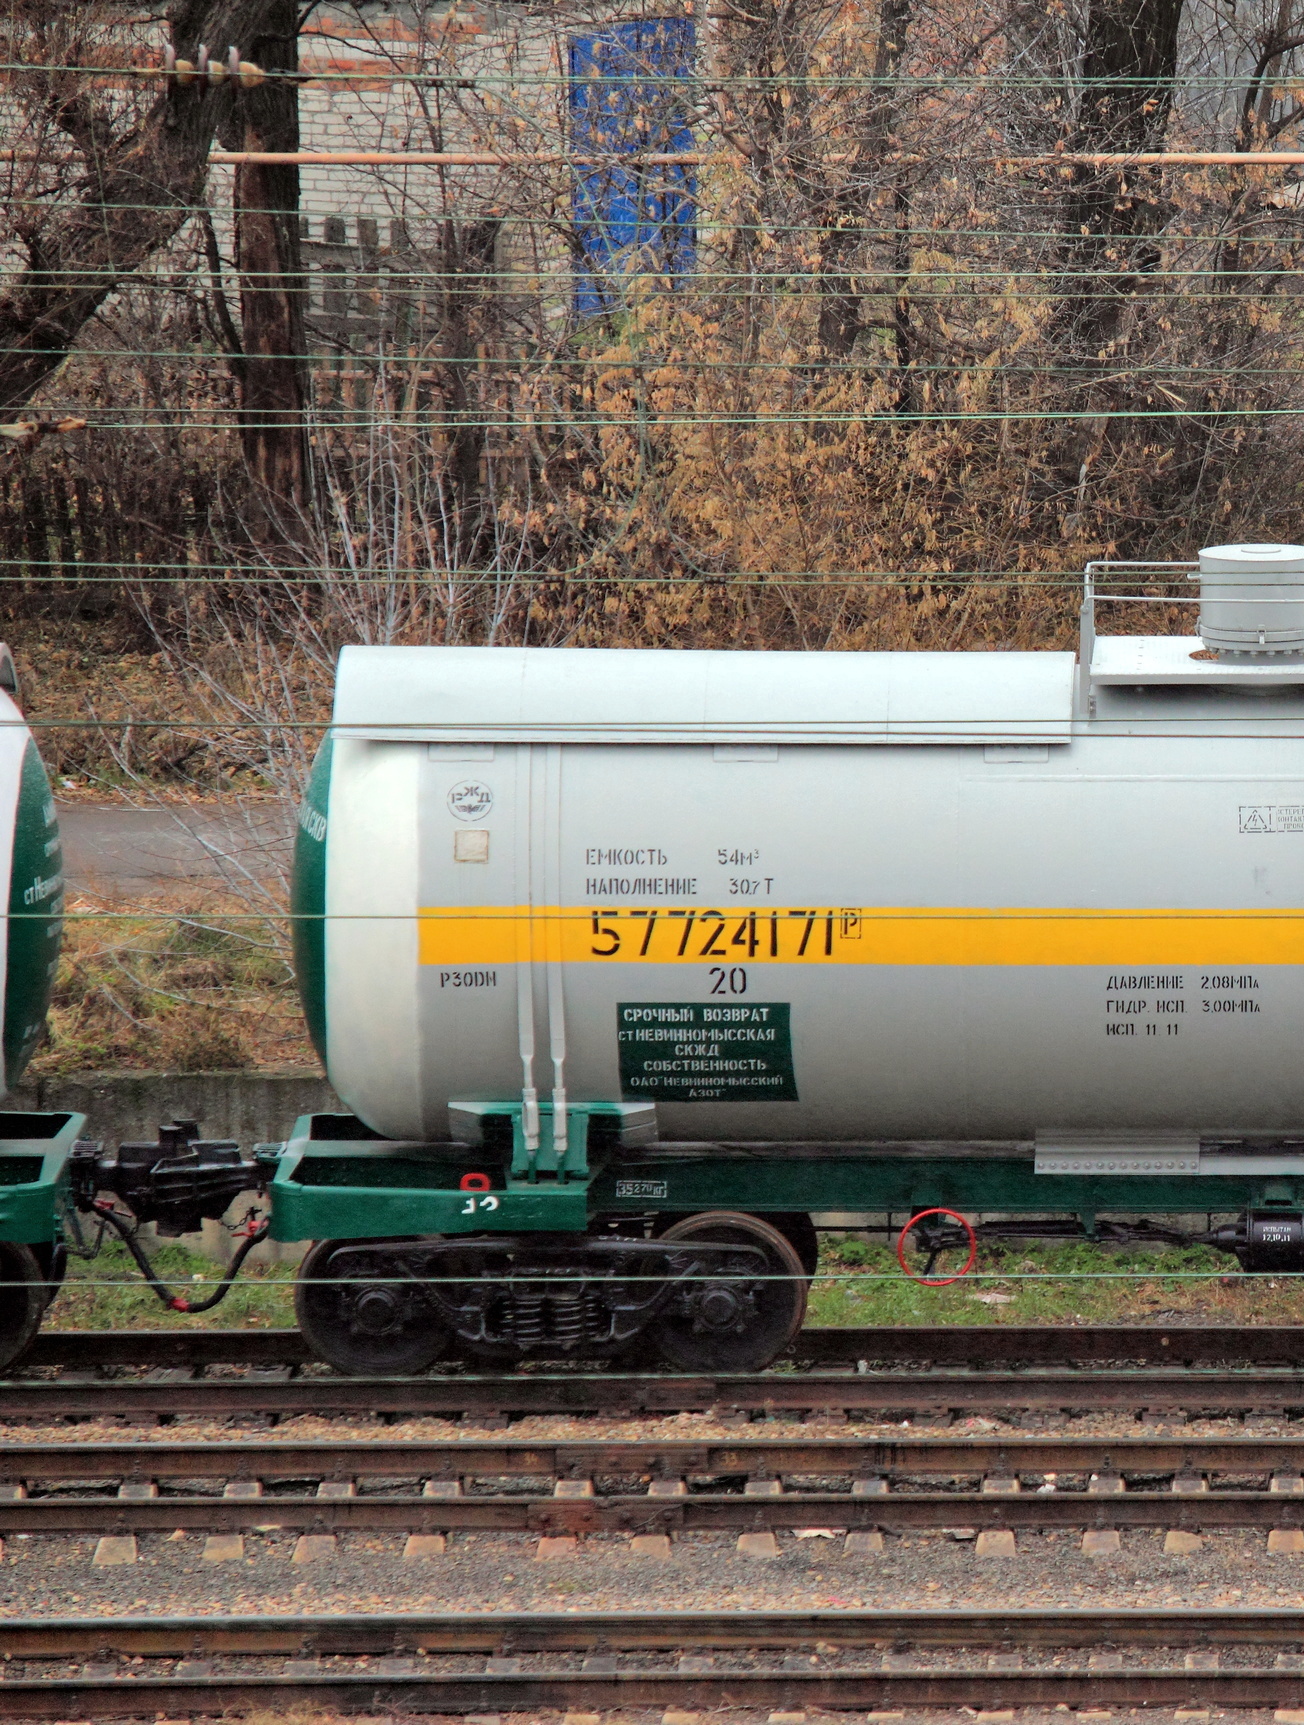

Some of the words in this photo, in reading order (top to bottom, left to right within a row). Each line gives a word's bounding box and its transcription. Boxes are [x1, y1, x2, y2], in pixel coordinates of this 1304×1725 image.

[451, 786, 491, 804] РЖД
[586, 849, 668, 866] ЕМКОСТЬ
[586, 878, 698, 895] НАПОЛНЕНИЕ
[591, 910, 834, 957] 57724171
[709, 967, 747, 994] 20
[1106, 975, 1184, 991] ДАВЛЕНИЕ
[623, 1006, 694, 1022] СРОЧНЫЙ
[703, 1008, 770, 1022] ВОЗВРАТ
[635, 1028, 776, 1042] НЕВИННОМЫССКАЯ
[674, 1044, 720, 1057] СКЖД
[643, 1060, 767, 1071] СОБСТВЕННОСТЬ
[630, 1077, 659, 1087] ОАО
